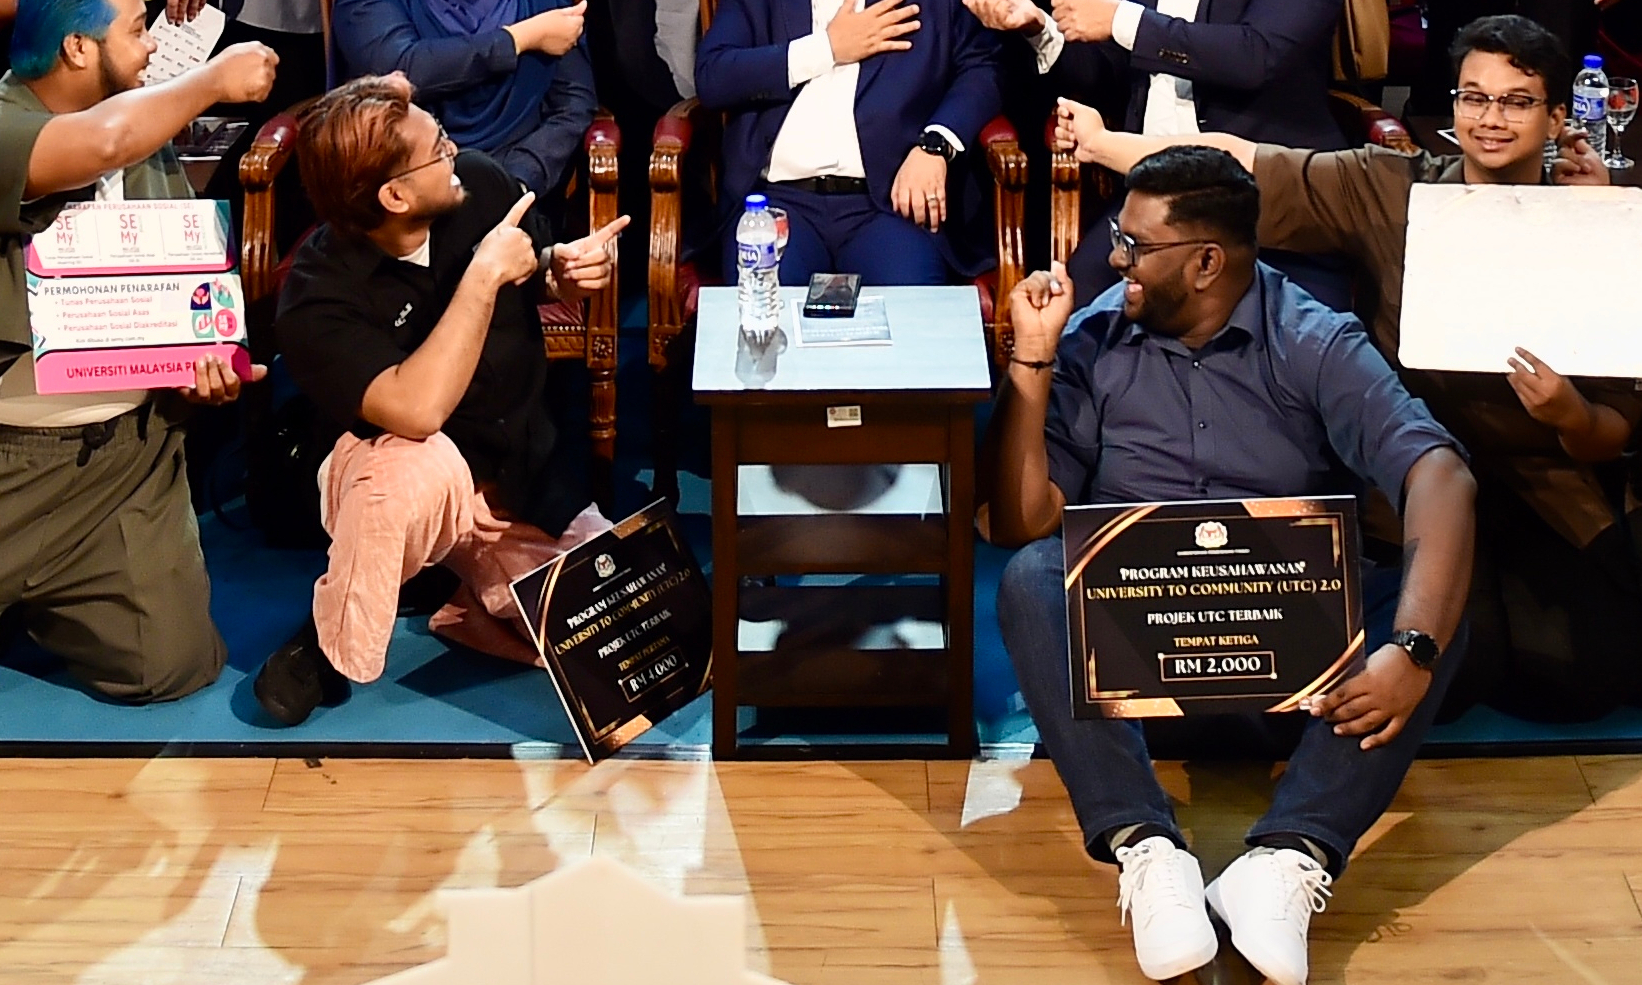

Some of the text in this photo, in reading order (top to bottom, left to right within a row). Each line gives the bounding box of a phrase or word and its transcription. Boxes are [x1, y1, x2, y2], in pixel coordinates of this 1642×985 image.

[44, 283, 180, 295] PERMOHONAN PENARAFAN
[67, 363, 182, 378] UNIVERSITI MALAYSIA
[1086, 579, 1342, 600] UNIVERSITY TO COMMUNITY (UTC) 2.0
[1147, 608, 1283, 626] PROJEK UTC TERBAIK
[1173, 635, 1259, 648] TEMPAT KETIGA
[1175, 656, 1261, 675] RM 2,000
